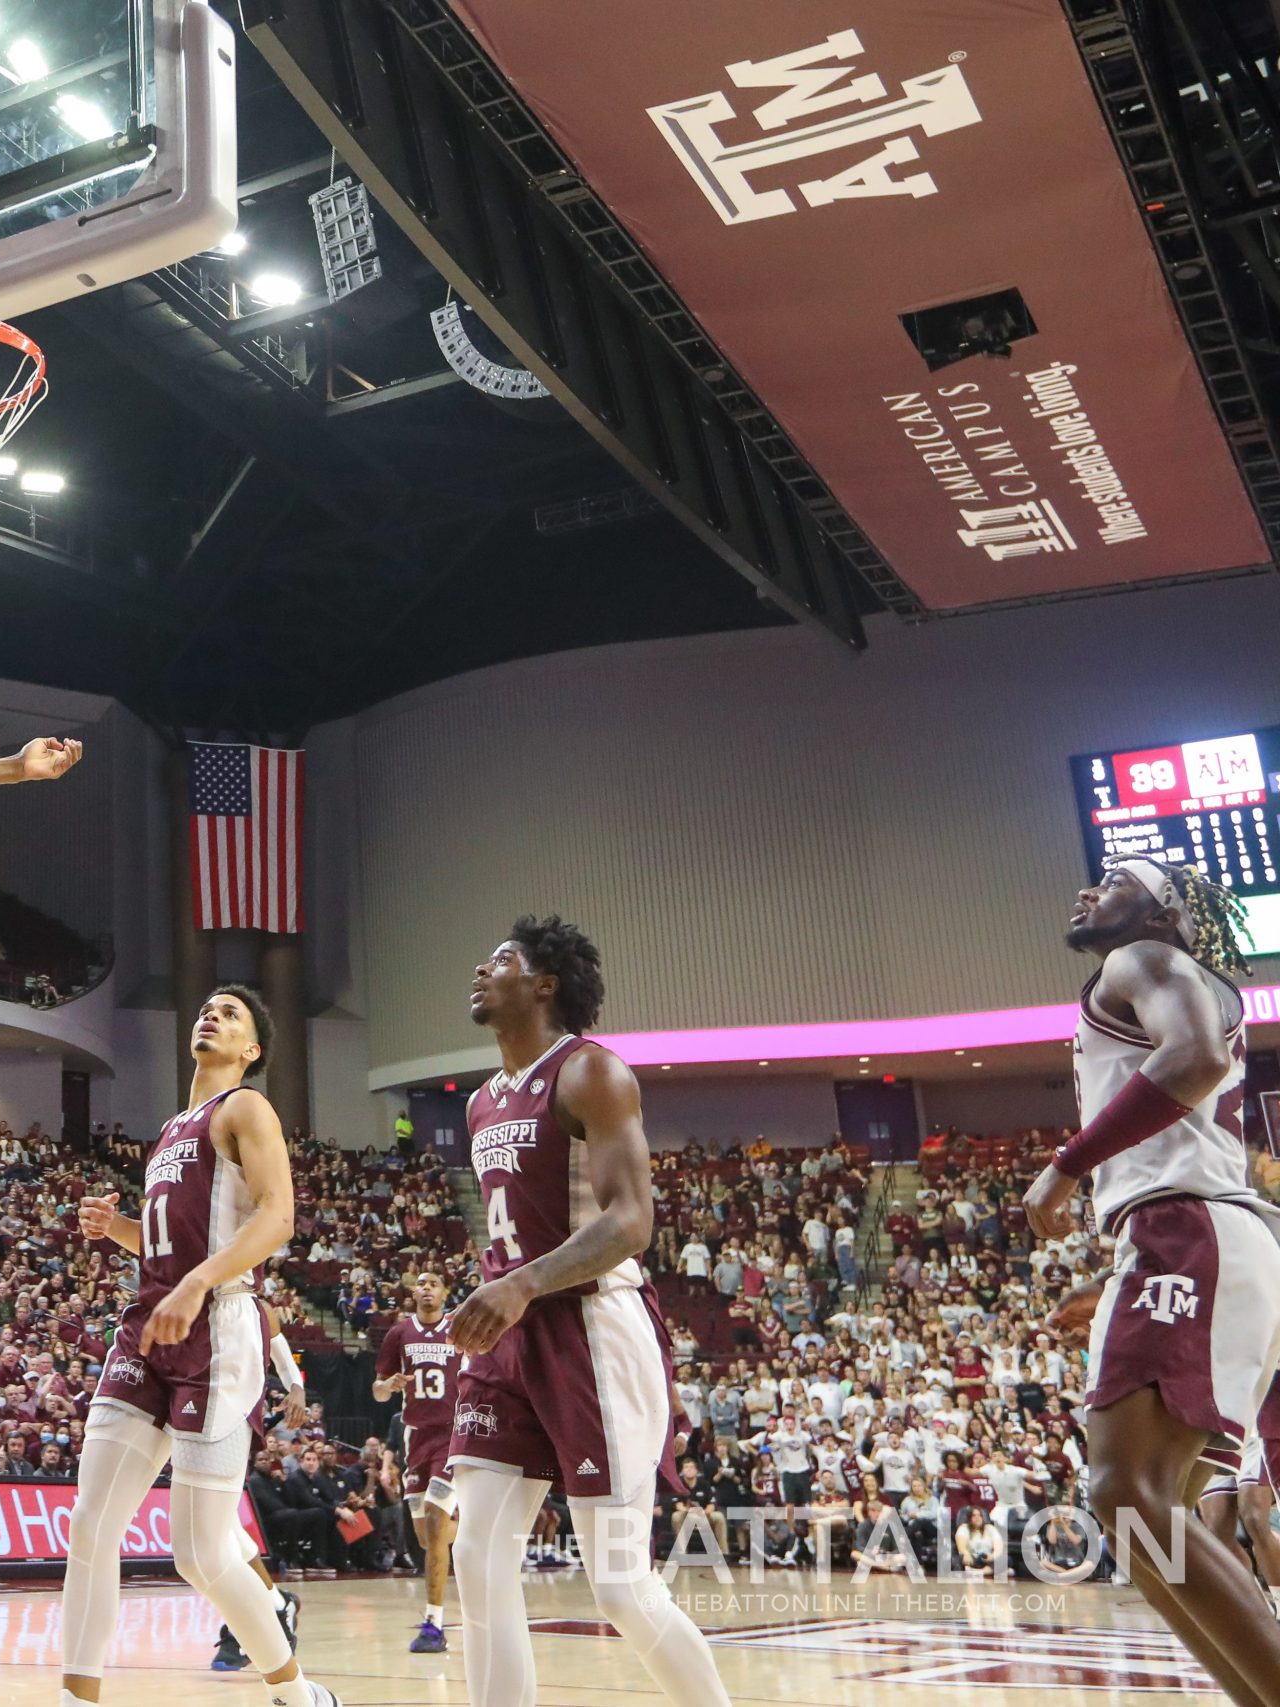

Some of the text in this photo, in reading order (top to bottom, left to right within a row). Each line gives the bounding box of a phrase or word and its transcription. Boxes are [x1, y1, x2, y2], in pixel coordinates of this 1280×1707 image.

[882, 392, 989, 501] AMERICAN
[937, 382, 1037, 497] CAMPUS
[1049, 411, 1097, 450] love
[1061, 443, 1127, 507] students
[1097, 501, 1148, 545] Where
[472, 1123, 537, 1152] ISSISSIPPI
[477, 1150, 508, 1173] STATE
[142, 1193, 173, 1260] 11
[488, 1185, 522, 1261] 4
[414, 1368, 445, 1399] 13
[459, 1411, 490, 1425] STATE
